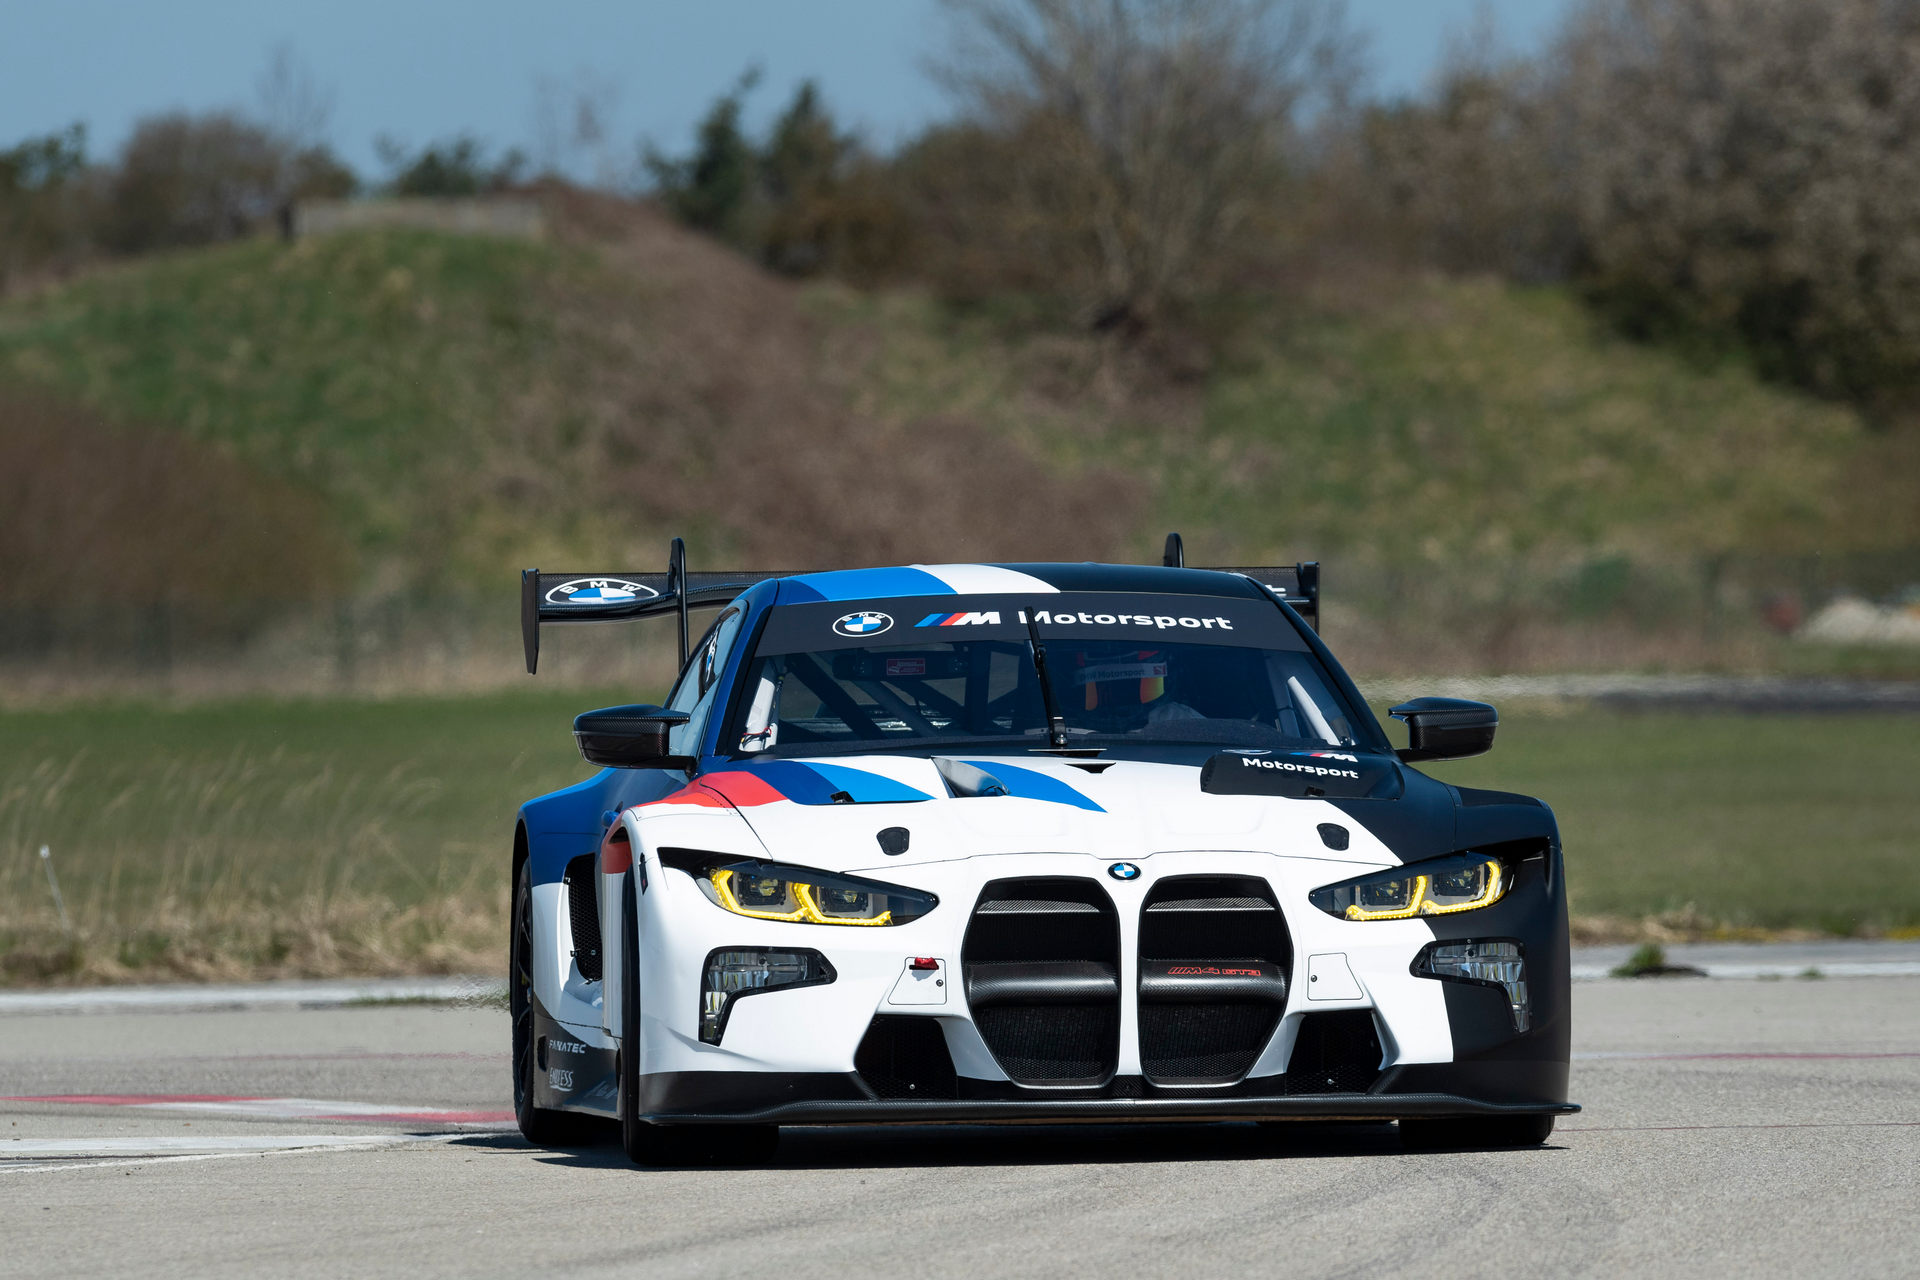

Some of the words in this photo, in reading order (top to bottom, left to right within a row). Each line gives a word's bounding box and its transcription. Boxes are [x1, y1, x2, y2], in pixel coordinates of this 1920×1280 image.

[559, 580, 641, 594] BMW
[1018, 610, 1233, 630] Motorsport
[1242, 757, 1359, 779] Motorsport
